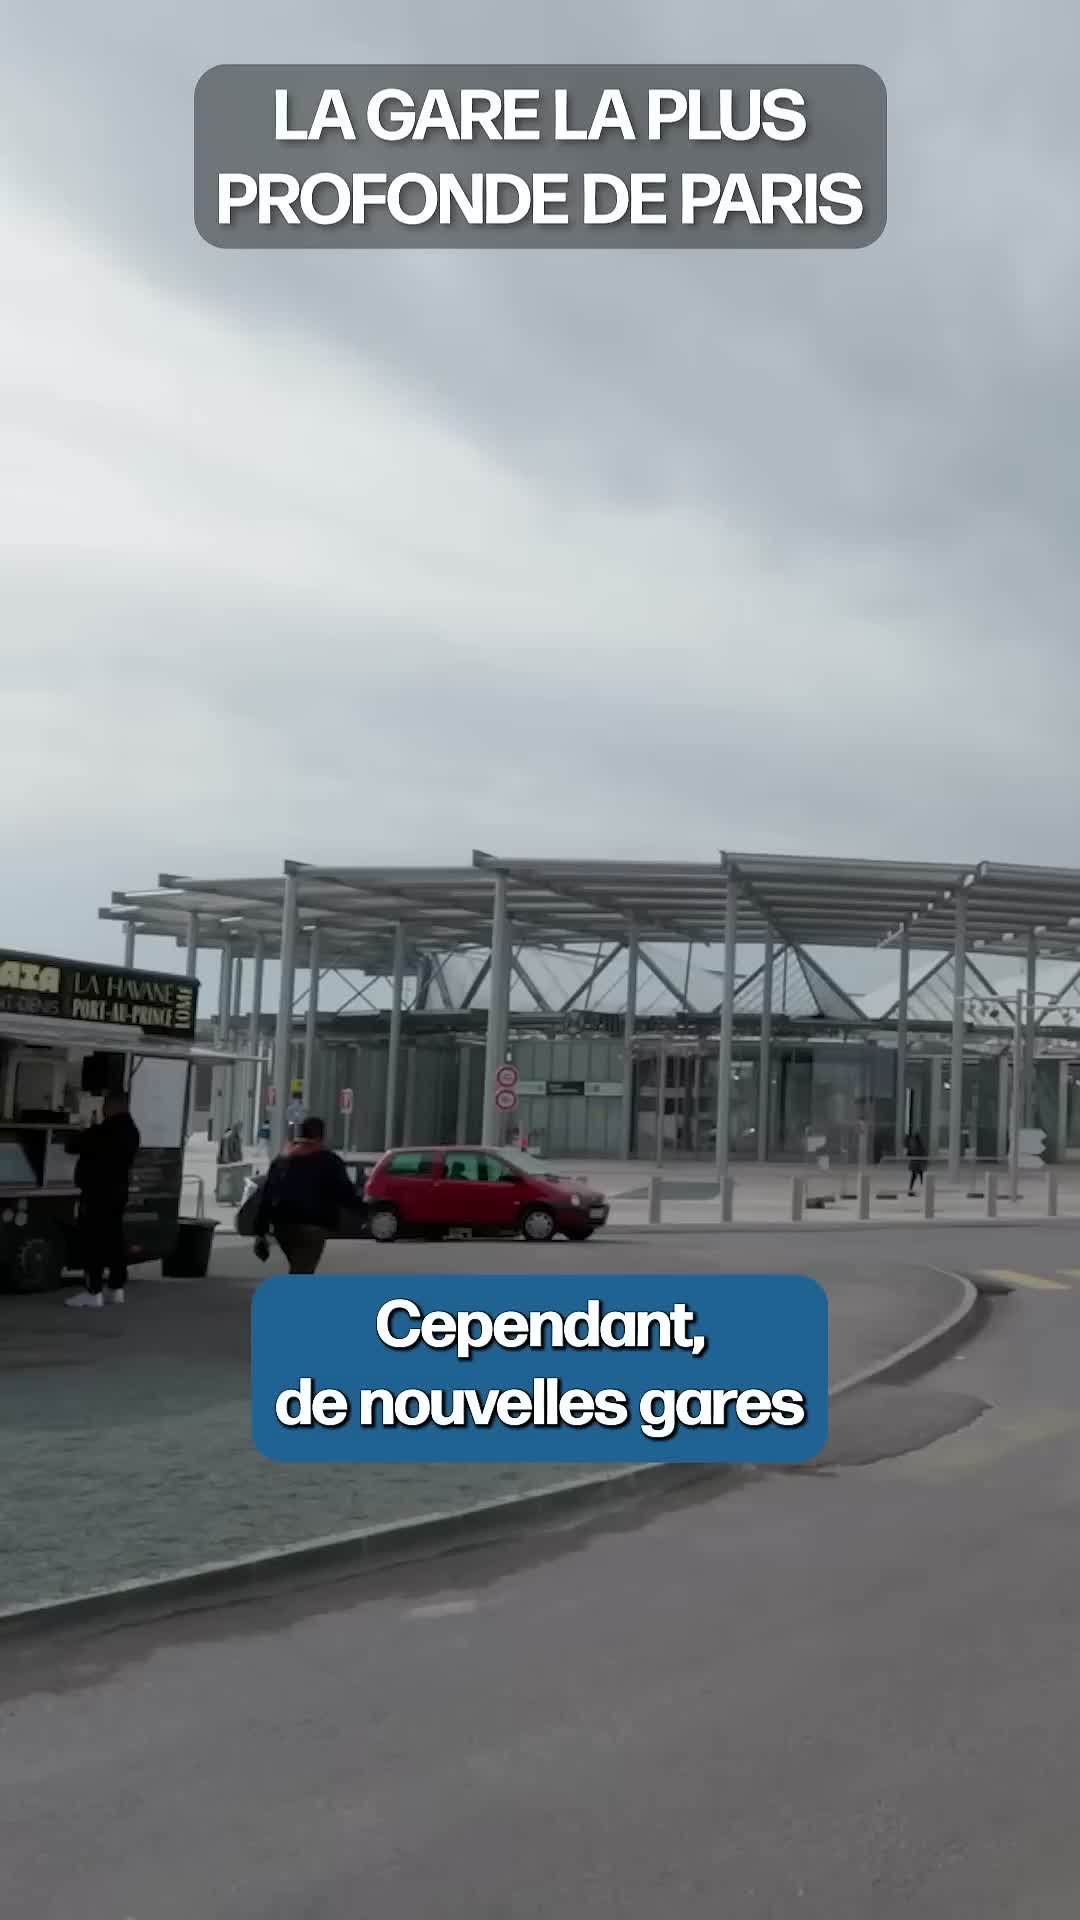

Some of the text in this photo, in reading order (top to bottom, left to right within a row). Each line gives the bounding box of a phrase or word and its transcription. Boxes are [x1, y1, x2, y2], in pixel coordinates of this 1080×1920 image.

[75, 972, 174, 1003] LA HAVANE
[72, 998, 172, 1028] PORT-AU-PRINCE
